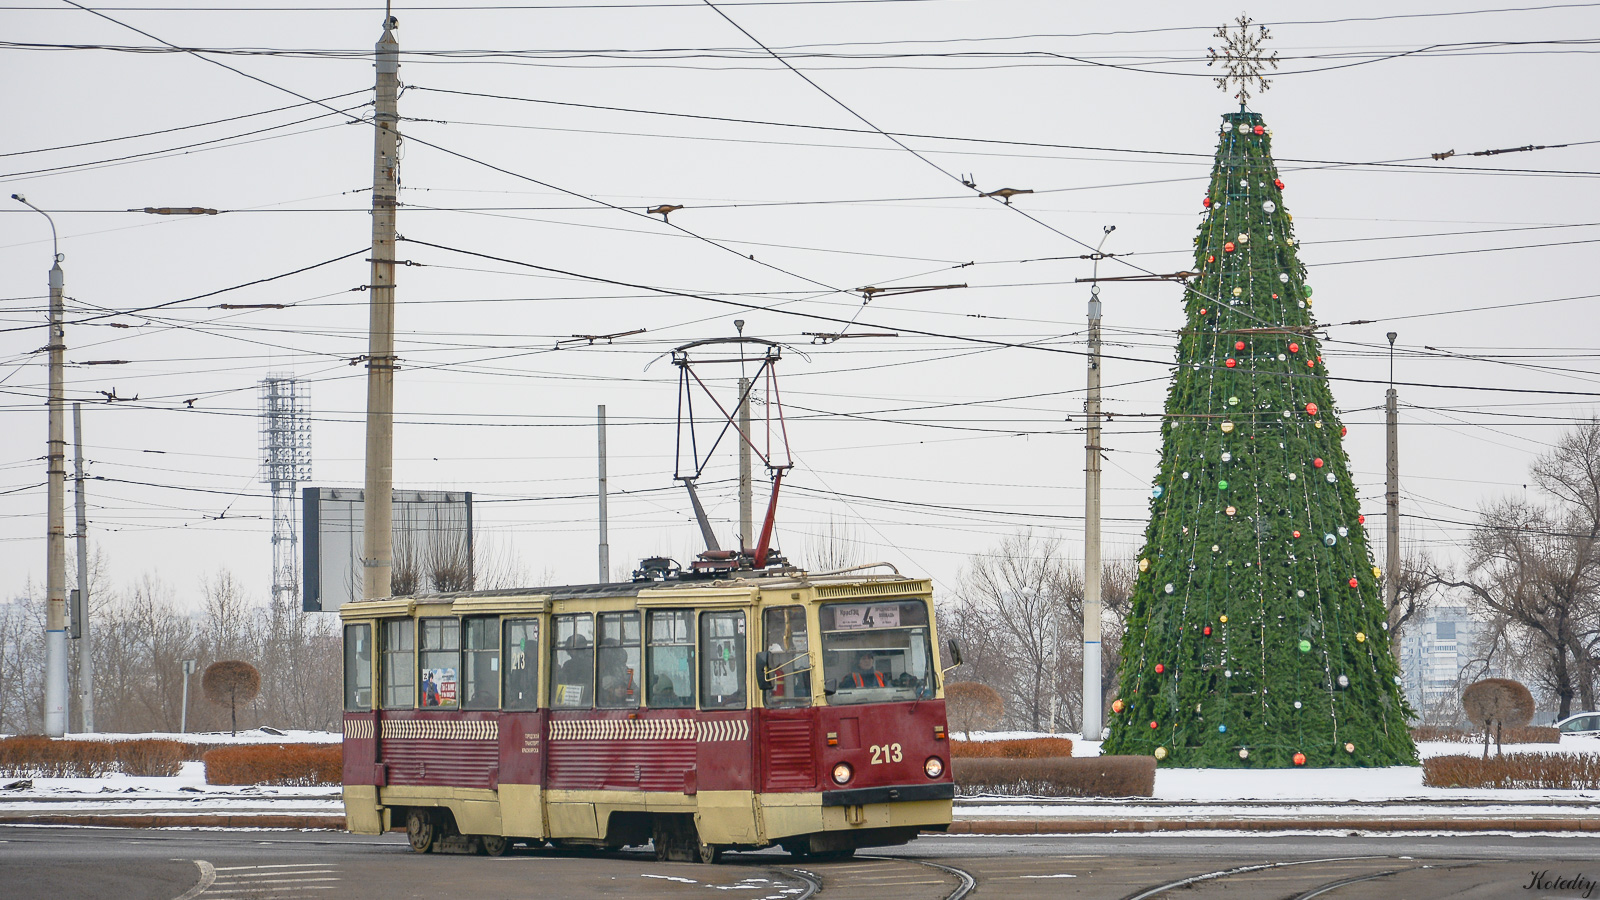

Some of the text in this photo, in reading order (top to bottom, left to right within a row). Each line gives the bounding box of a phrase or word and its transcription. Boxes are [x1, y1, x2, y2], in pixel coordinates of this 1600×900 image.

[862, 606, 874, 628] 4
[512, 652, 525, 670] 213
[870, 743, 902, 764] 213
